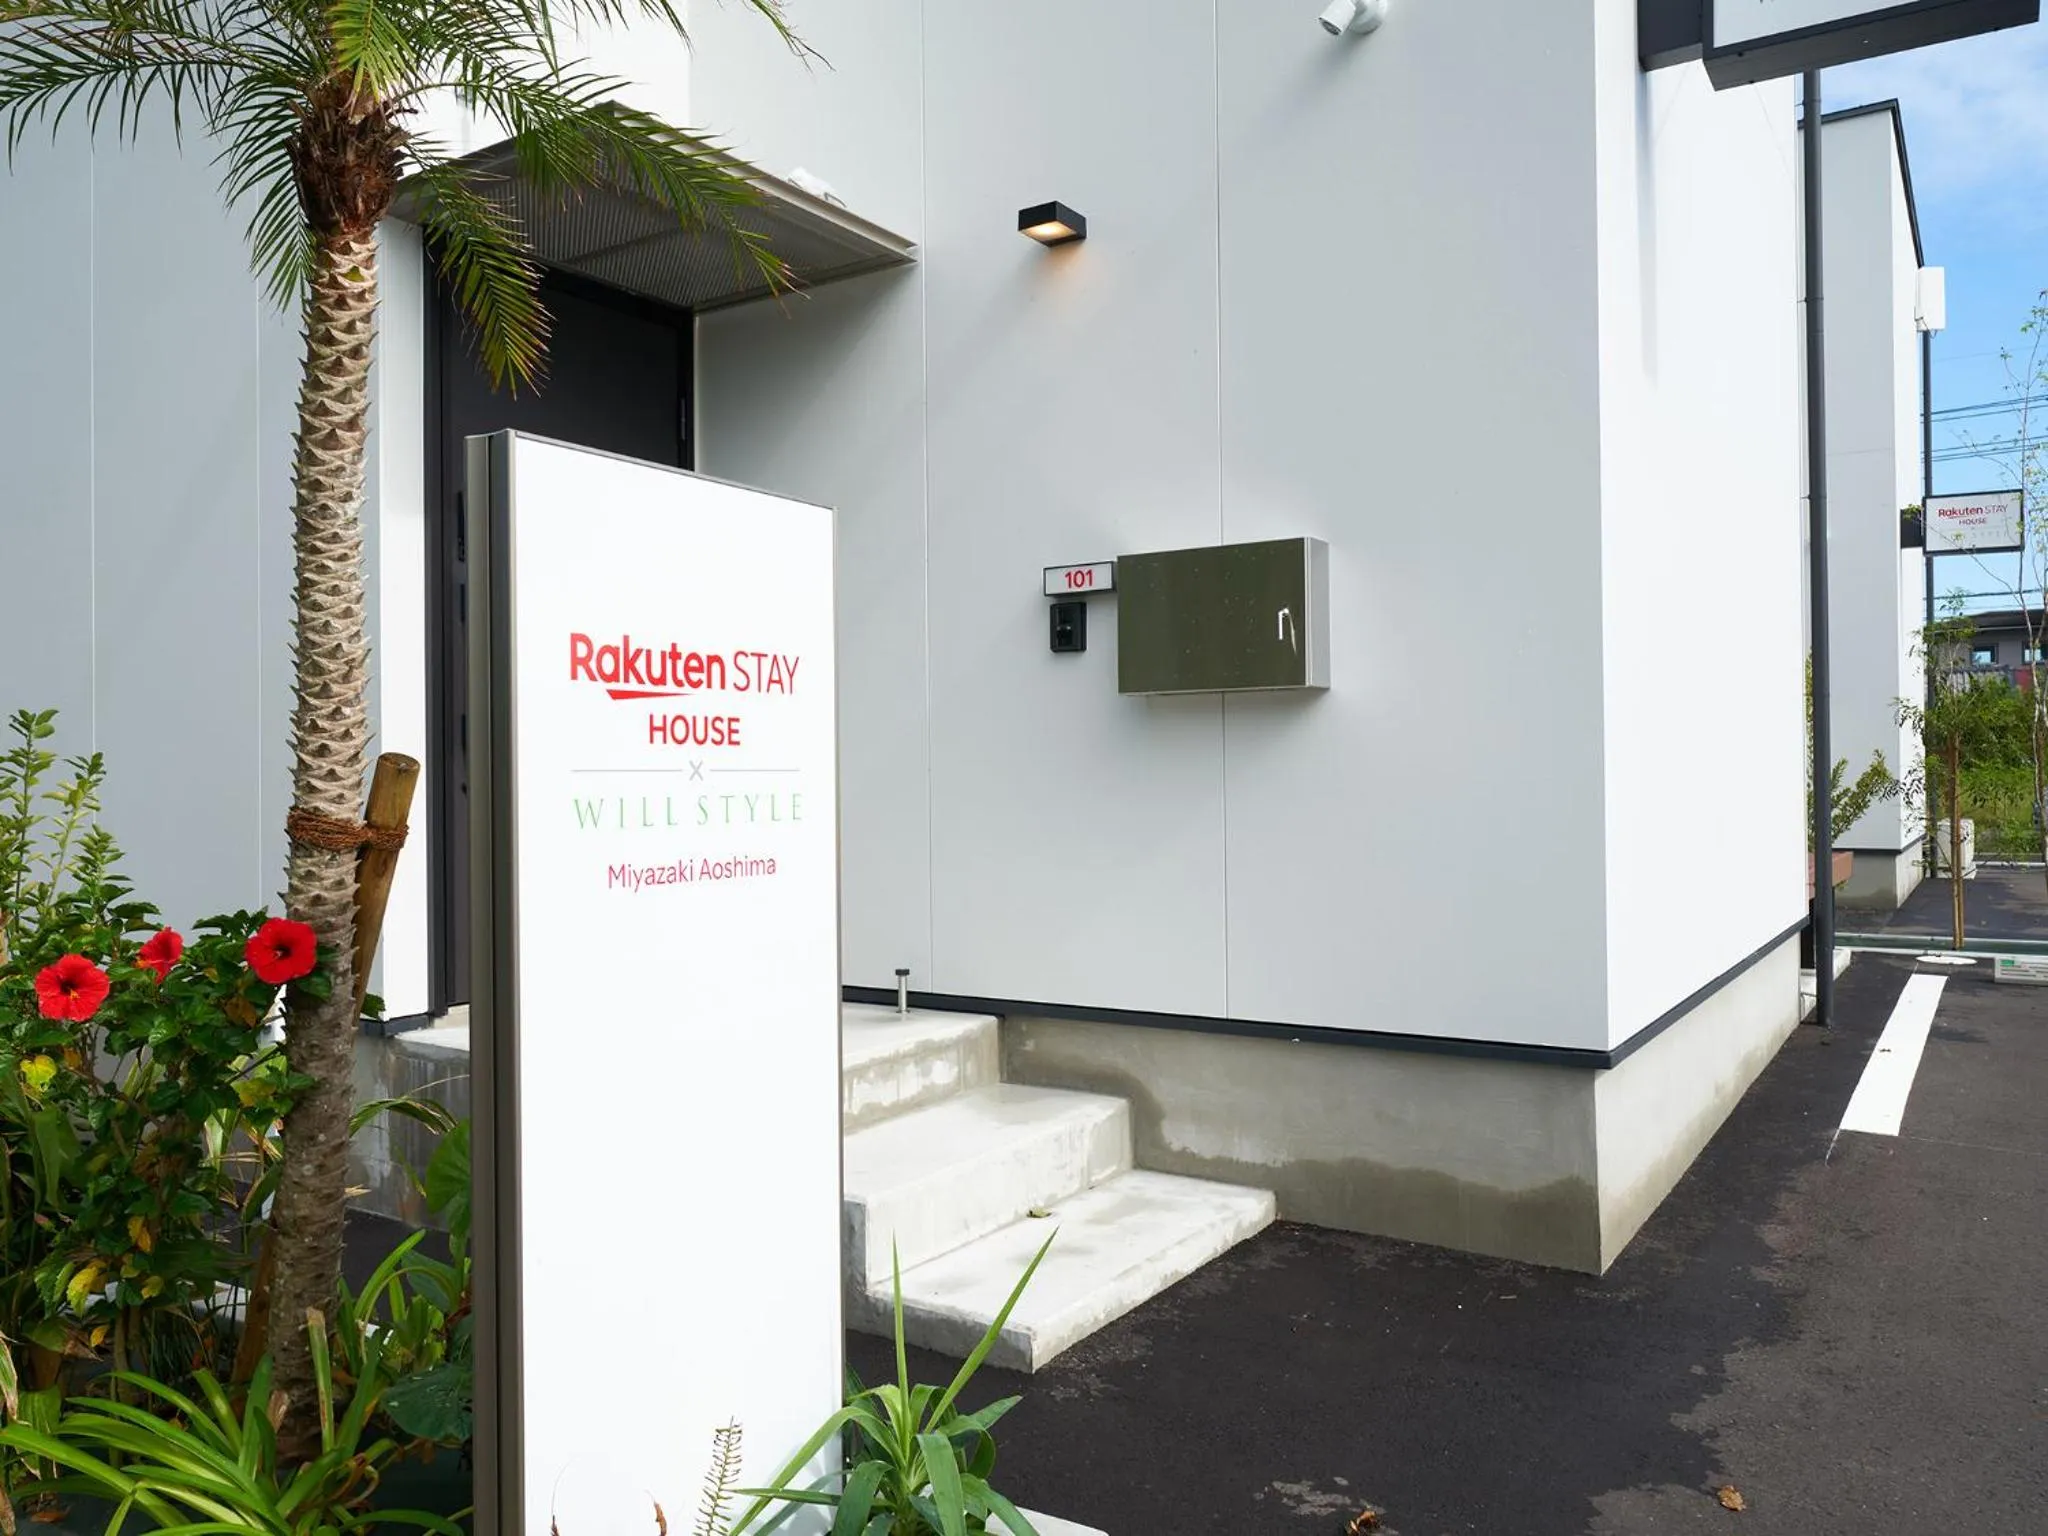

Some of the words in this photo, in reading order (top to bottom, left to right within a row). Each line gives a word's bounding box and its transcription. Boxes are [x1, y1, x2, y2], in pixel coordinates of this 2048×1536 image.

[1938, 507, 1983, 517] Rakuten
[1985, 504, 2009, 514] STAY
[1959, 517, 1987, 525] HOUSE
[1065, 569, 1093, 588] 101
[570, 633, 726, 690] Rakuten
[733, 650, 800, 694] STAY
[649, 713, 741, 746] HOUSE
[573, 796, 678, 829] WILL
[697, 793, 802, 825] STYLE
[608, 859, 693, 893] Miyazaki
[699, 855, 777, 881] Aoshima
